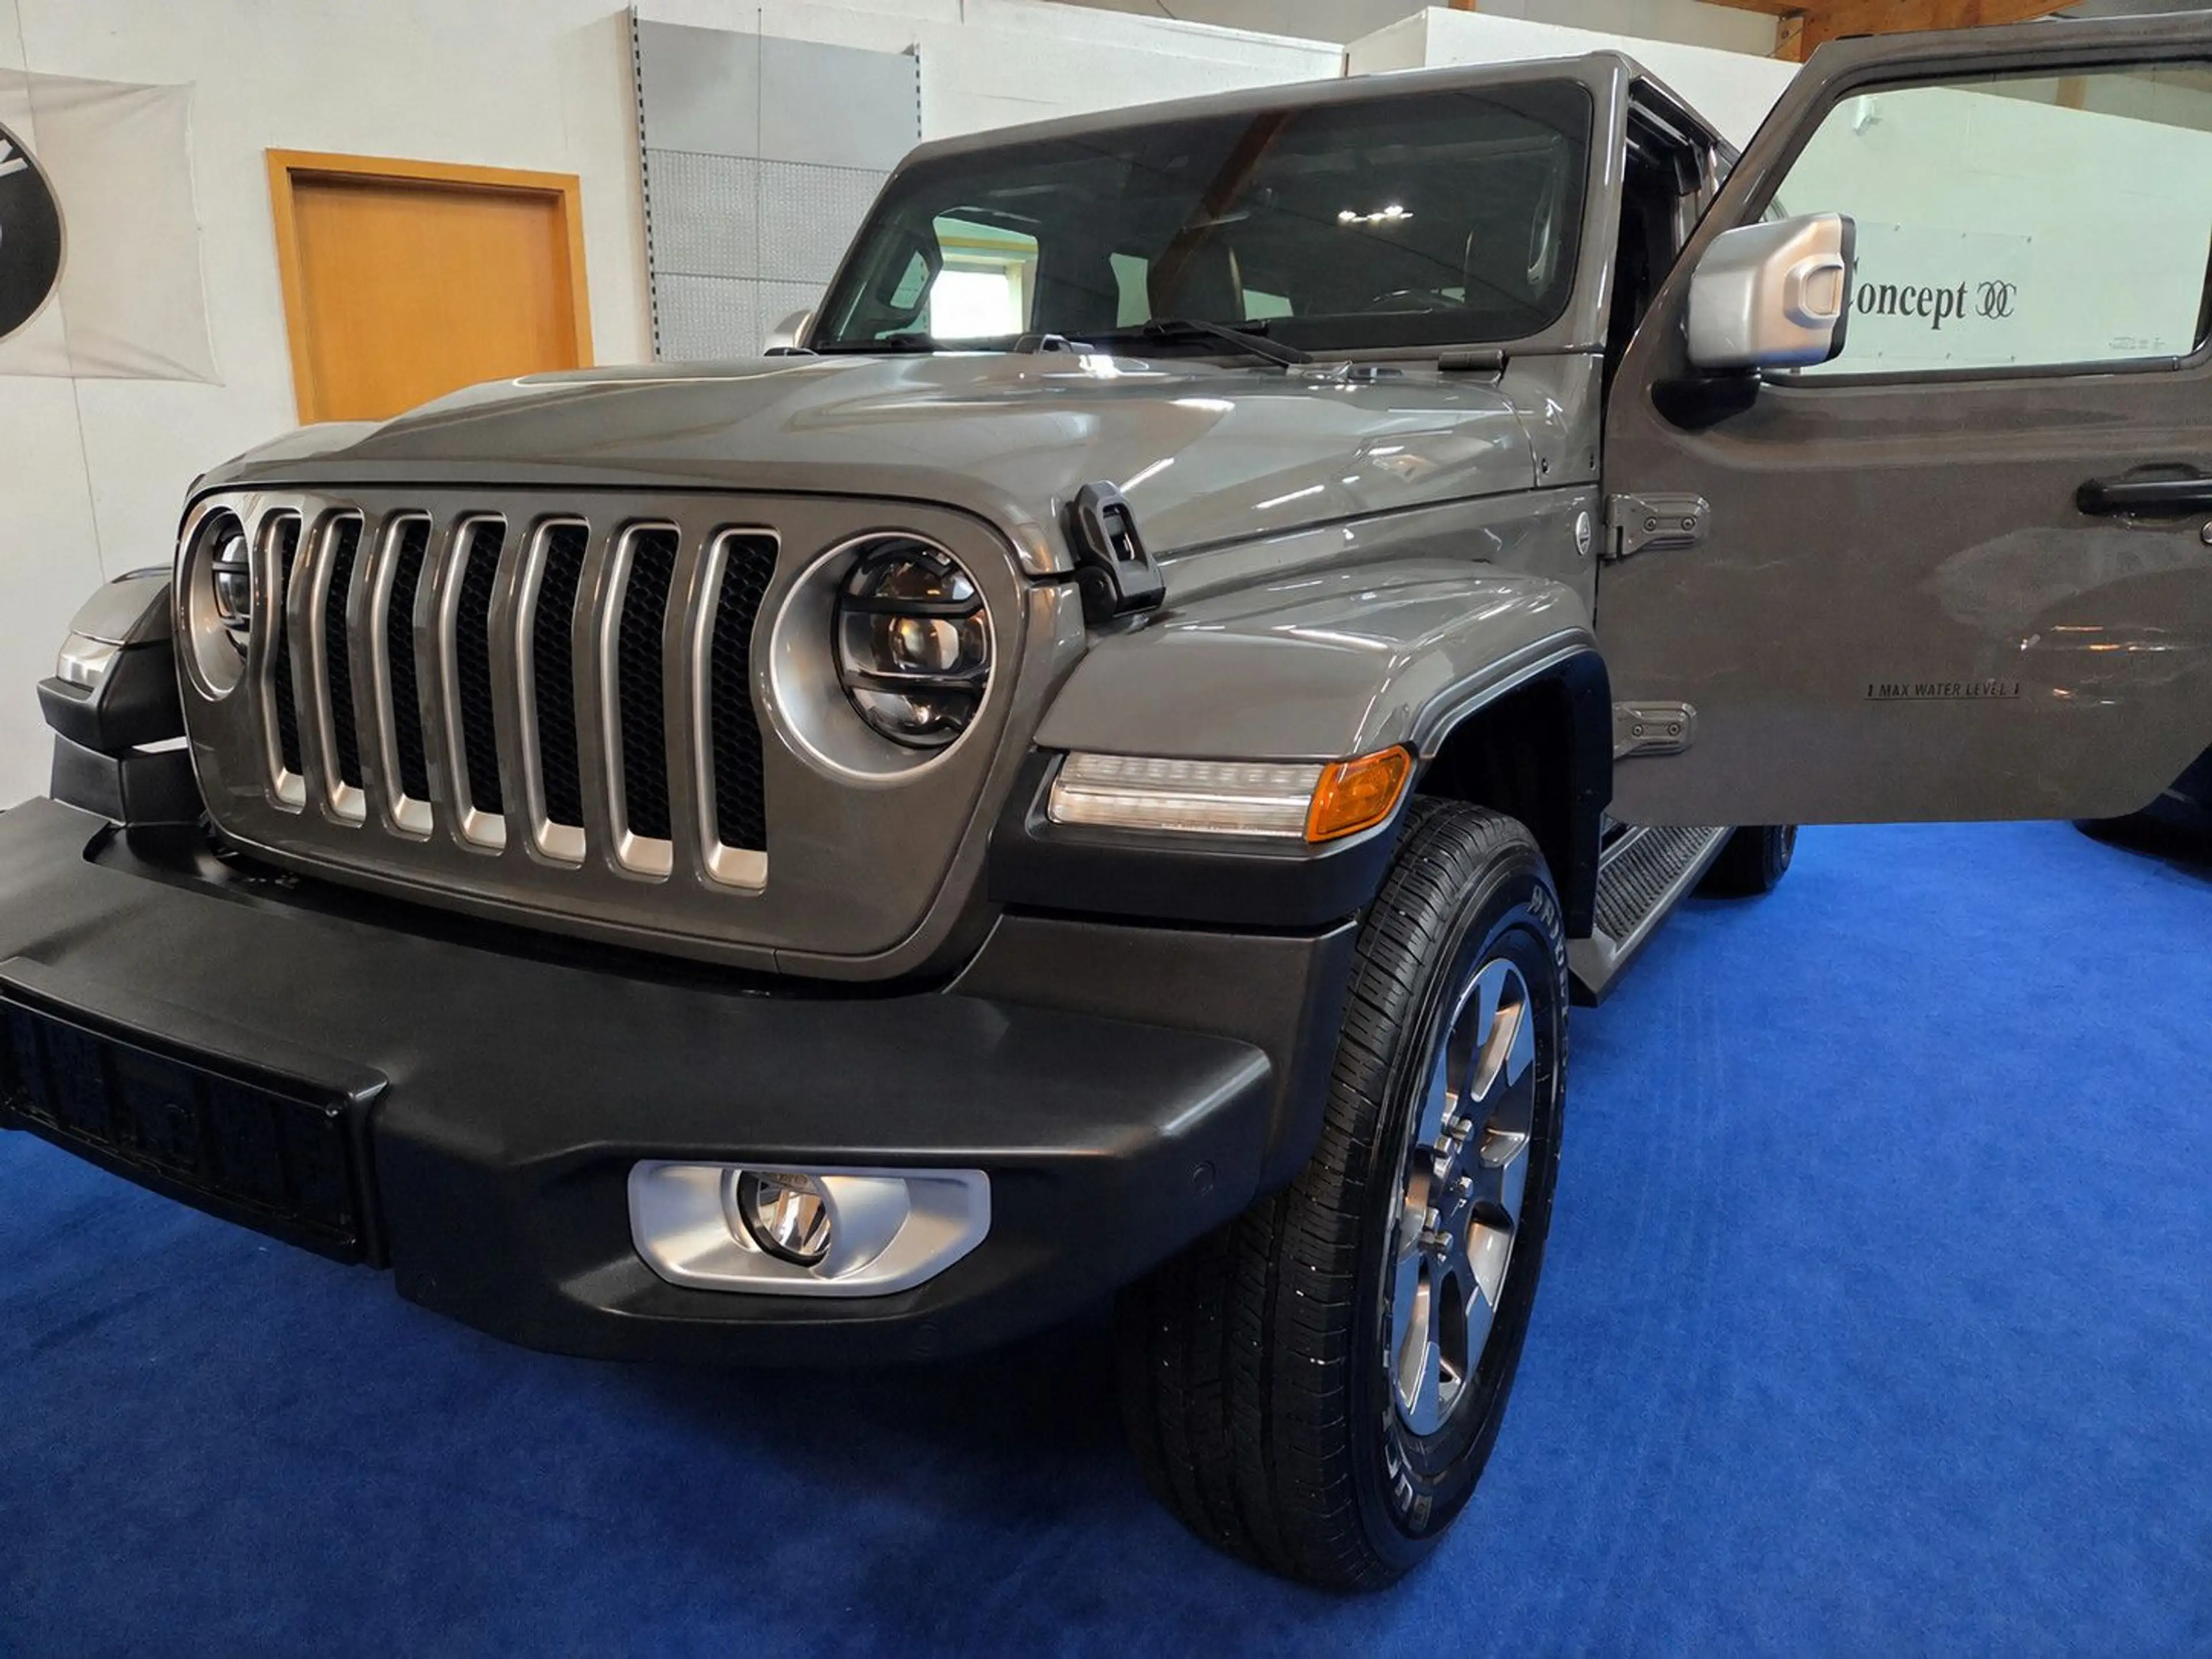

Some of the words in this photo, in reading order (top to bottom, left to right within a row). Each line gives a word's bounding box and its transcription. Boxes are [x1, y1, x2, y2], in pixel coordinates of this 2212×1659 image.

[1849, 281, 1968, 330] oncept
[1878, 683, 1910, 697] MAX
[1915, 683, 1960, 696] WATER
[1966, 681, 2006, 696] LEVEL
